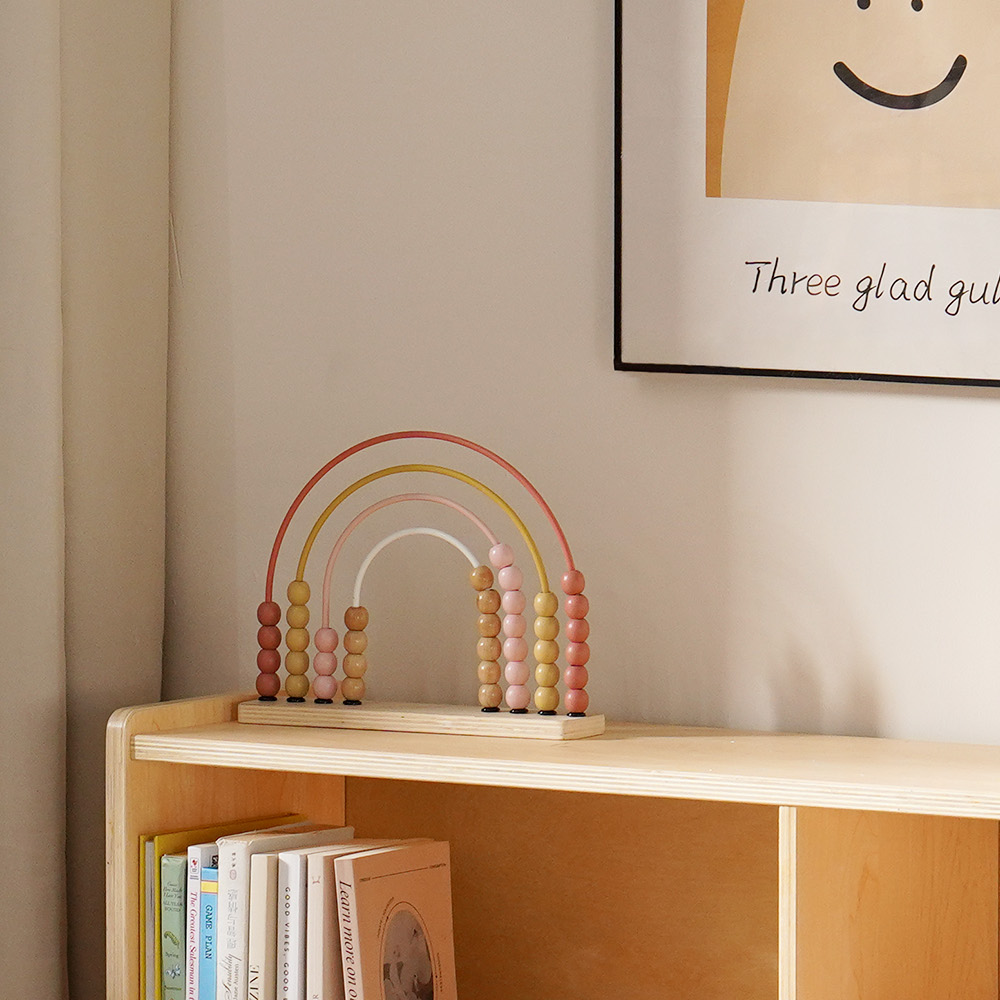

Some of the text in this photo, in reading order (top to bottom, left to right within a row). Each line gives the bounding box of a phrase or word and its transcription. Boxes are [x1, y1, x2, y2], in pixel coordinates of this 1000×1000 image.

[745, 257, 841, 297] Three
[852, 262, 936, 312] glad
[190, 892, 198, 907] The
[339, 880, 352, 923] Learn
[189, 908, 198, 943] Greatest
[205, 904, 213, 960] GAME PLAN
[188, 945, 197, 985] Salesman
[343, 926, 355, 965] more
[189, 987, 196, 995] in
[346, 966, 356, 986] on
